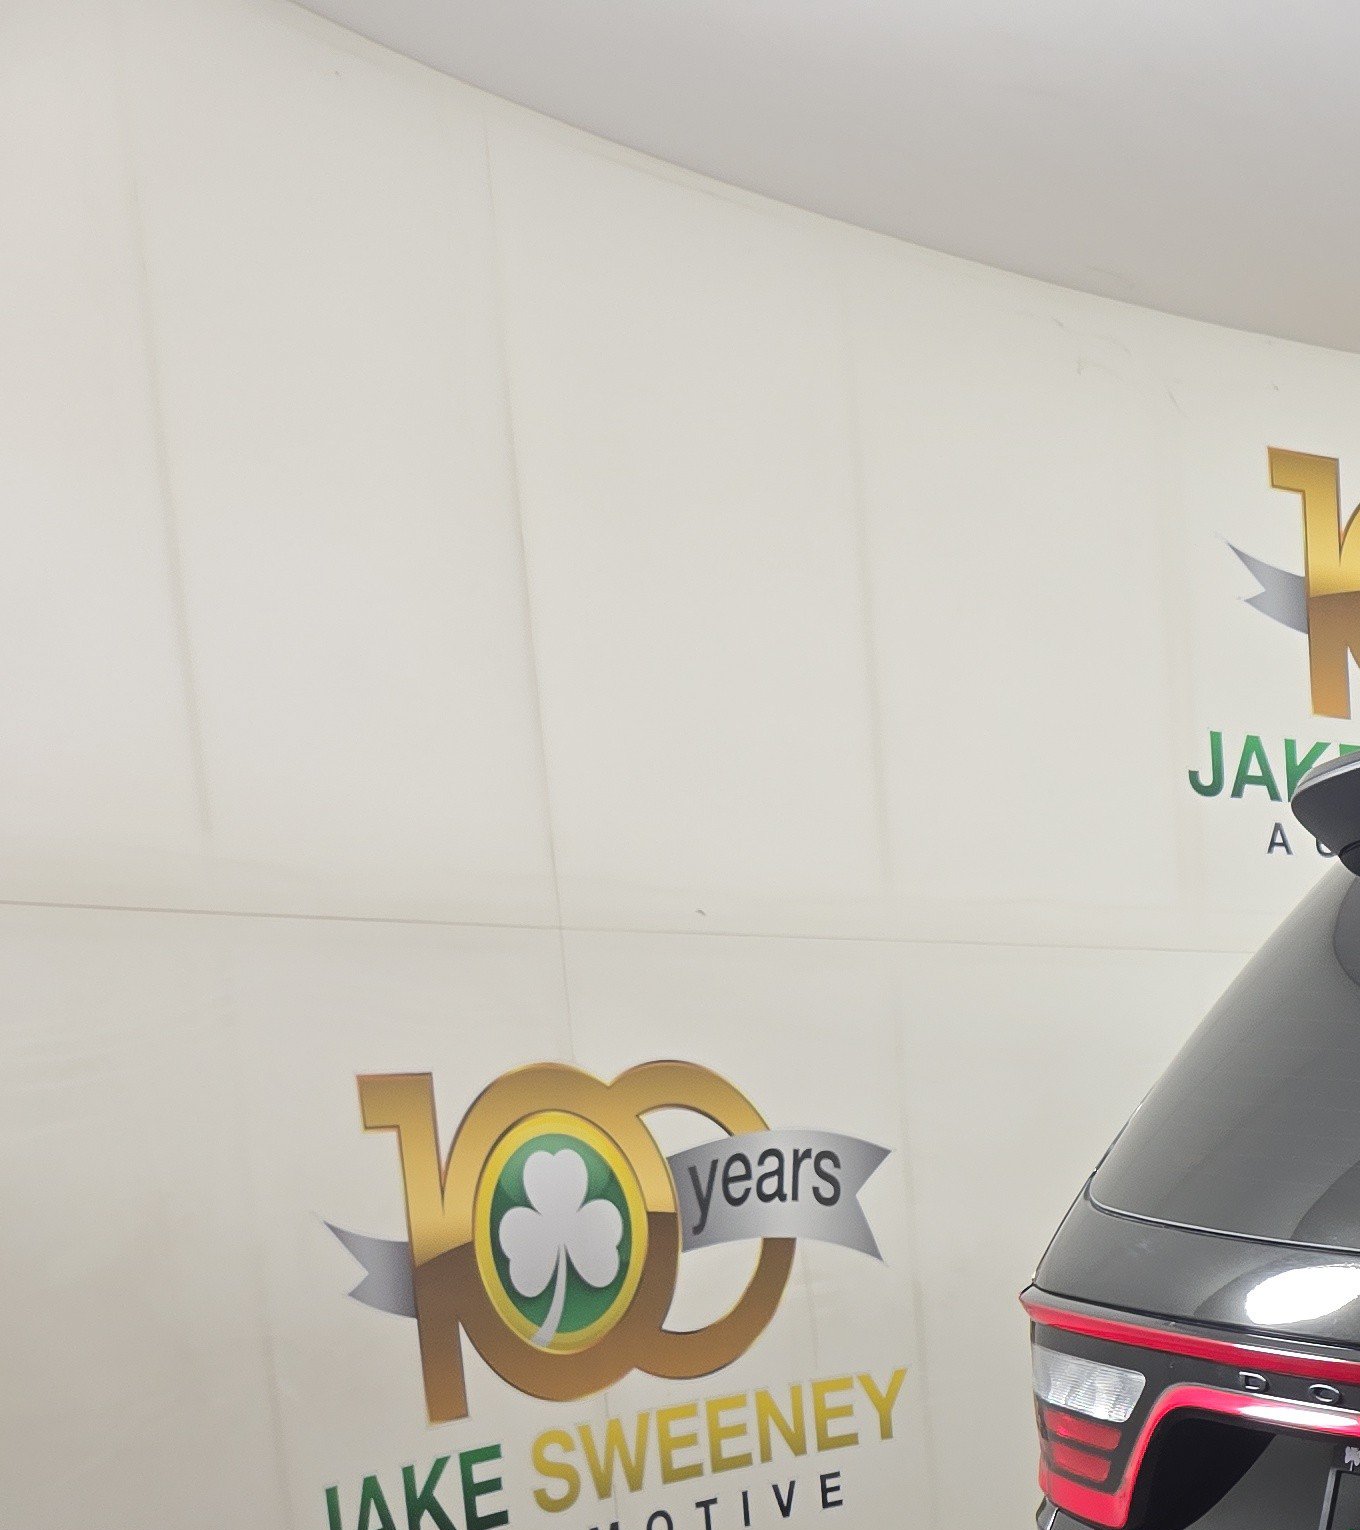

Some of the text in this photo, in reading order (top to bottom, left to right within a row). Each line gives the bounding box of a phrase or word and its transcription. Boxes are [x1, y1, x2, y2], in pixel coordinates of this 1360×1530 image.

[355, 1059, 843, 1425] 100 years
[530, 1367, 907, 1515] SWEENEY
